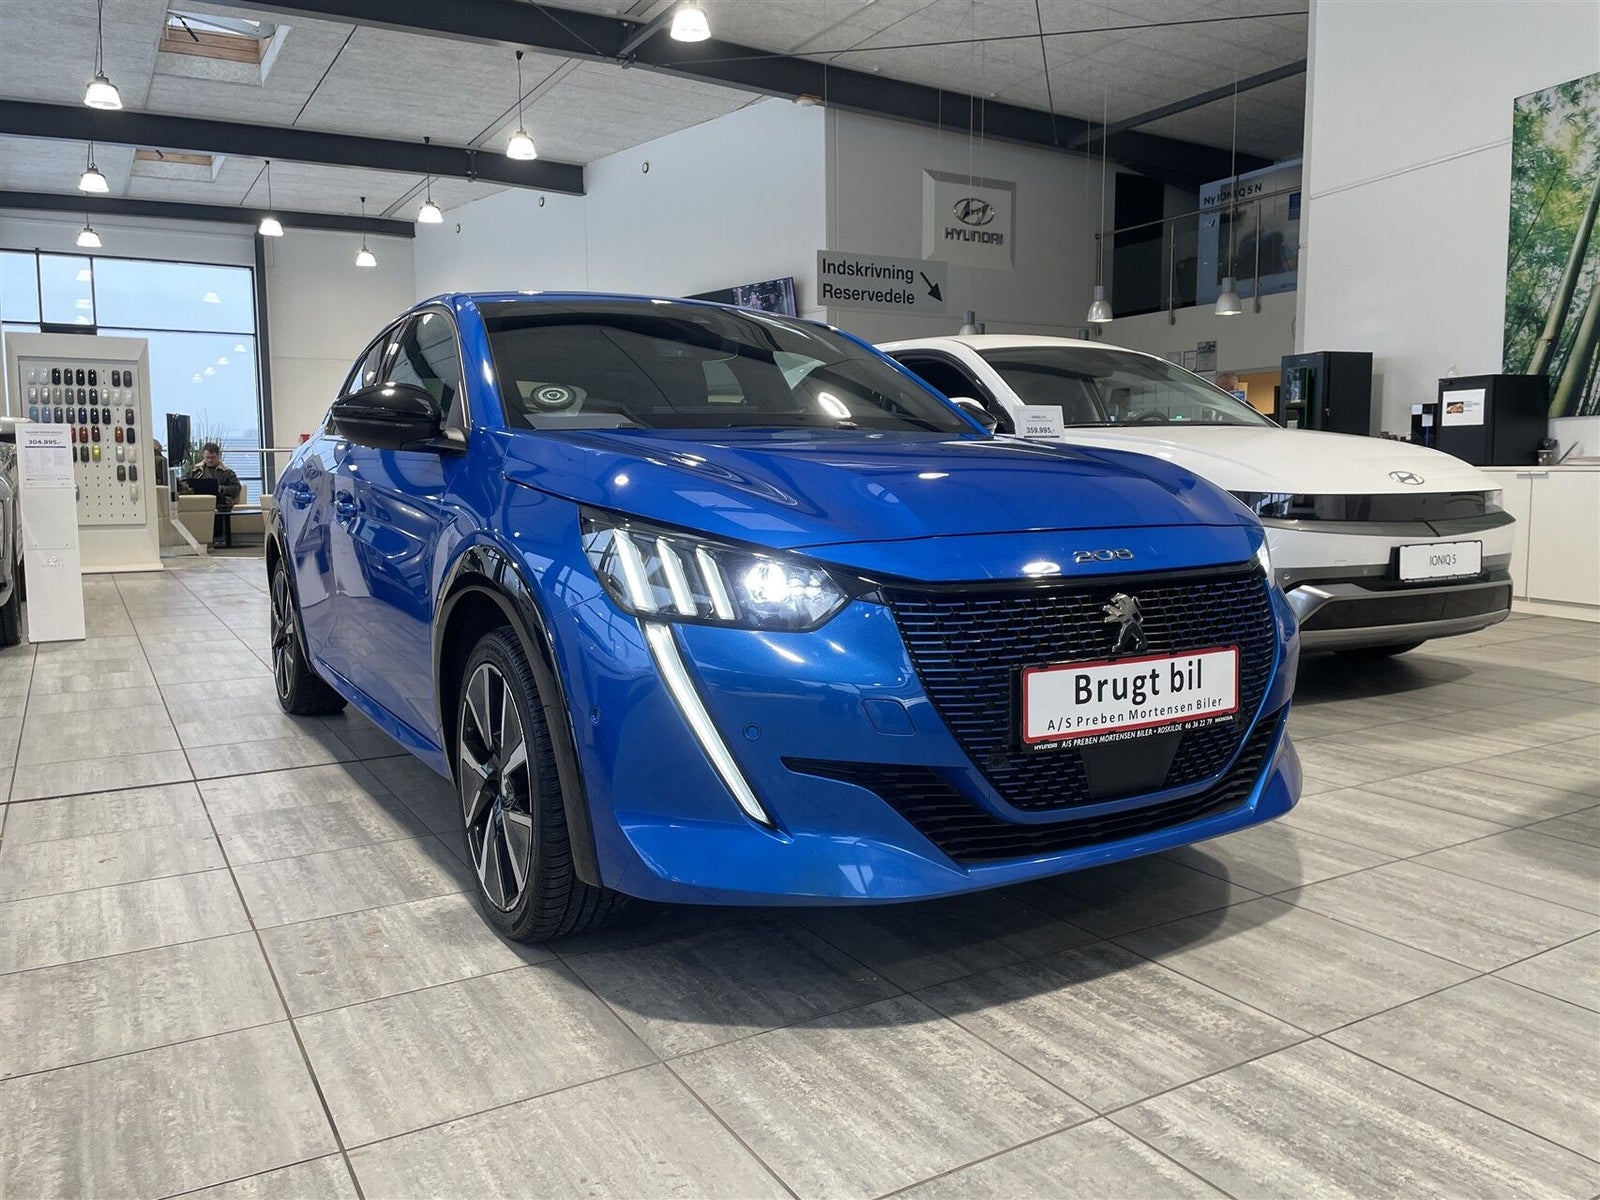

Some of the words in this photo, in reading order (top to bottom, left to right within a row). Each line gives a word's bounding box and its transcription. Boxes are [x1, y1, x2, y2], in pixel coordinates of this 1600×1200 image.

[1204, 195, 1215, 205] Ny
[1247, 185, 1253, 194] 5
[1254, 182, 1262, 193] N
[945, 227, 1003, 245] HYUNDAI
[822, 257, 915, 284] Indskrivning
[822, 283, 915, 305] Reservedele
[1073, 548, 1134, 564] 208
[1429, 554, 1451, 567] IONIQ
[1452, 554, 1457, 564] 5
[1075, 668, 1160, 706] Brugt
[1170, 658, 1202, 693] bil
[1047, 716, 1072, 732] A/S
[1077, 712, 1124, 727] Preben
[1128, 702, 1193, 721] Mortensen
[1196, 697, 1222, 710] Biler
[1061, 740, 1072, 749] A/S
[1073, 737, 1098, 747] PREBEN
[1098, 731, 1136, 744] MORTENSEN
[1136, 729, 1153, 738] BILER
[1157, 723, 1182, 735] ROSKILDE
[1184, 722, 1192, 730] 46
[1192, 721, 1199, 729] 36
[1199, 720, 1206, 728] 22
[1206, 718, 1213, 726] 79
